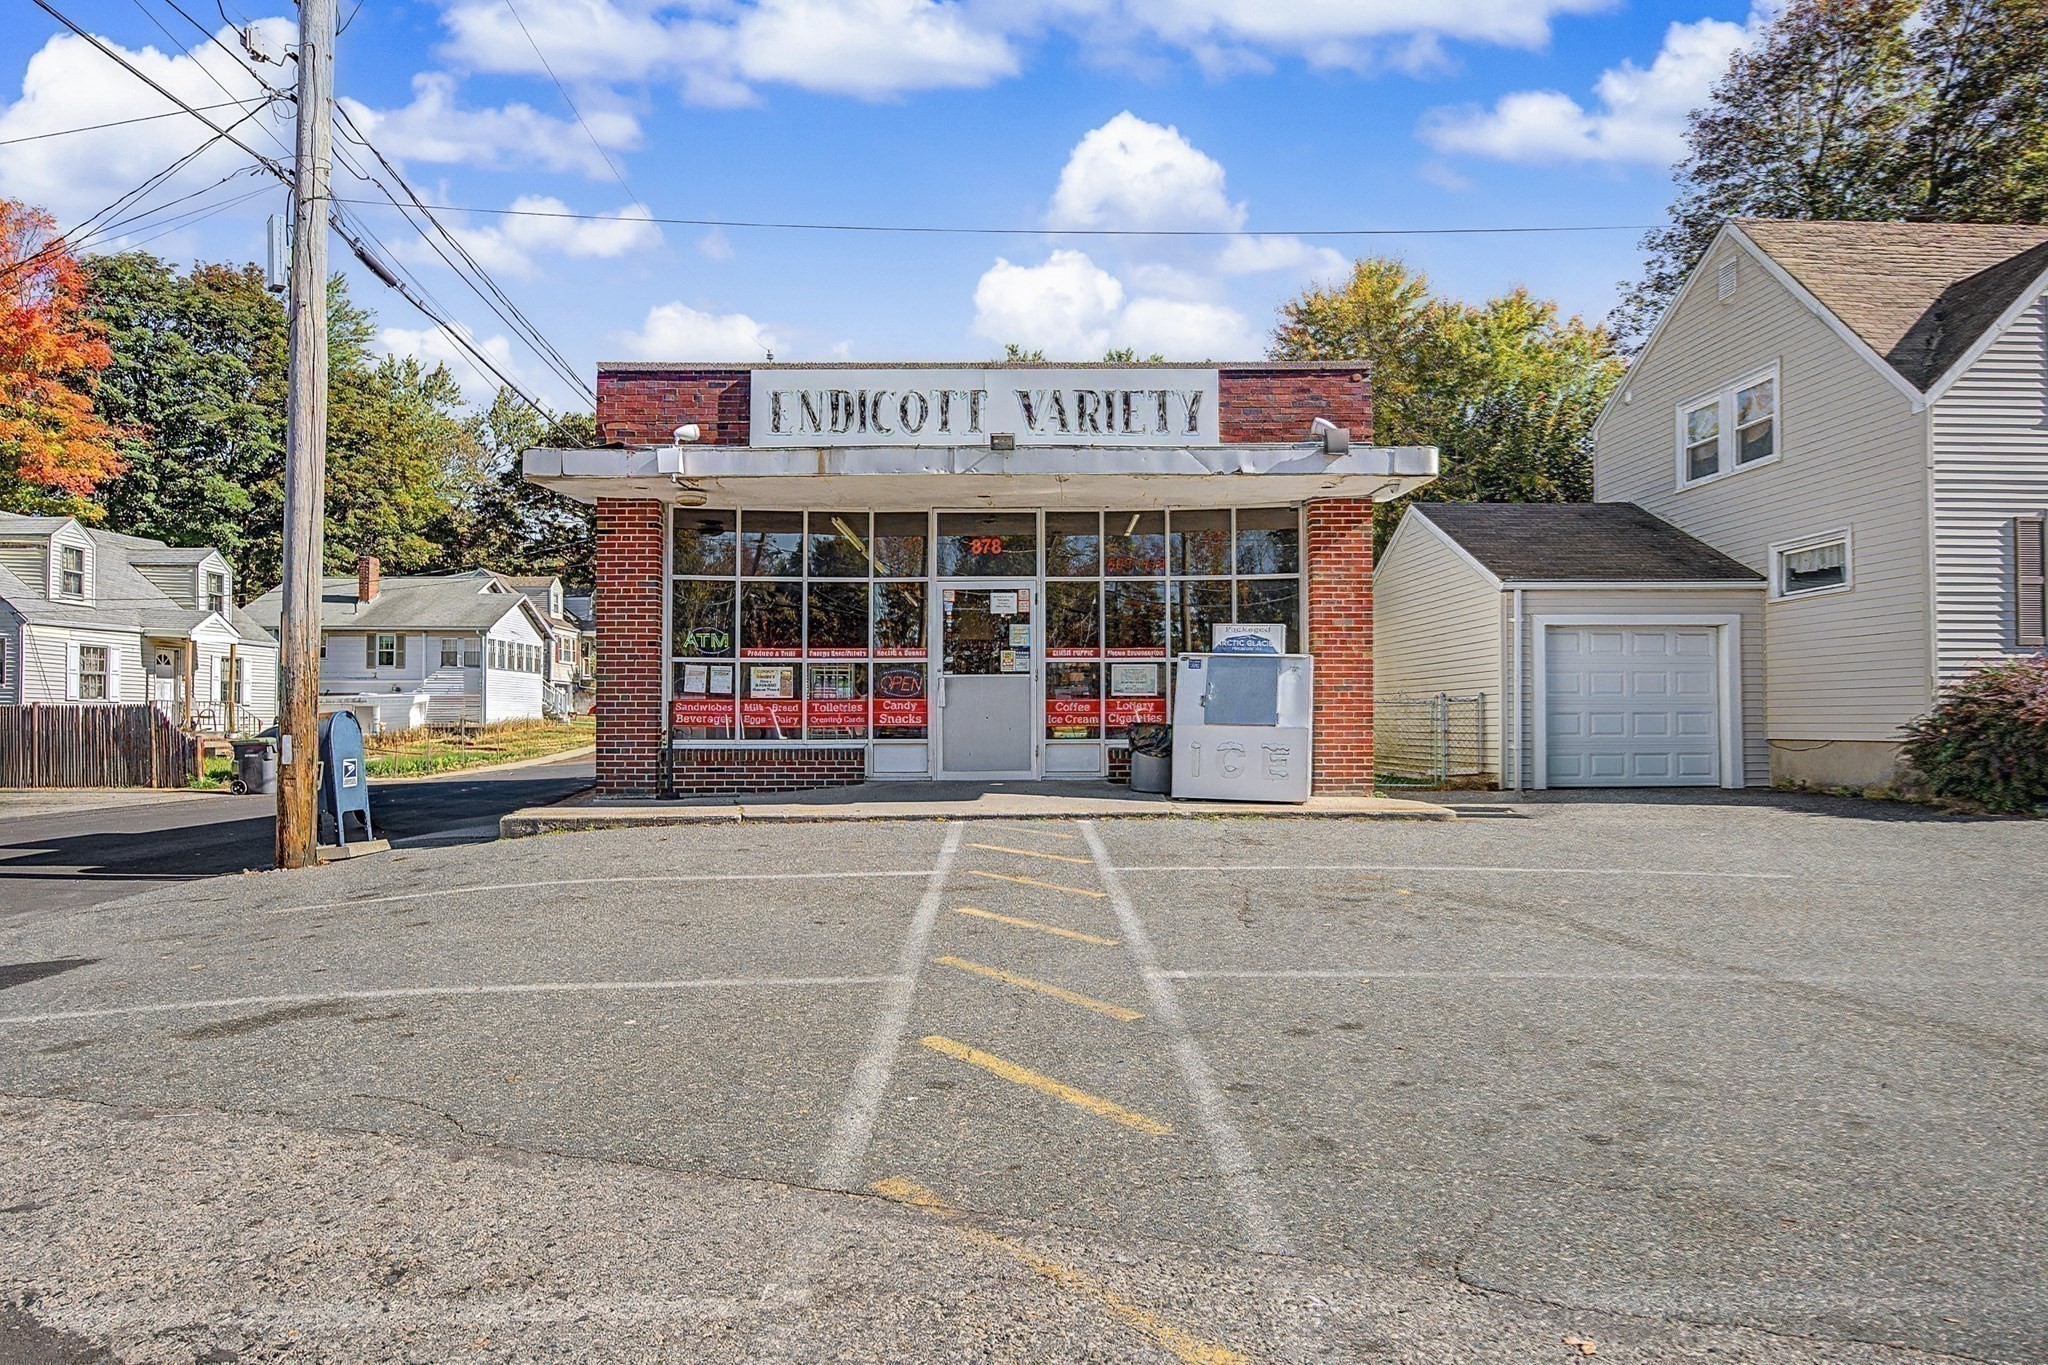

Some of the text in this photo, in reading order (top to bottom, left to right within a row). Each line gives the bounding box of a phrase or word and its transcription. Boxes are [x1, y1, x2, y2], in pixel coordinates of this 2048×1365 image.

[766, 388, 1205, 436] ENDICOTT VARIETY
[971, 538, 1001, 554] 878
[683, 631, 729, 648] ATM
[880, 675, 923, 691] OPEN
[675, 703, 733, 712] Sandwiches
[744, 703, 764, 711] Milk
[772, 703, 799, 712] Bread
[812, 703, 863, 712] Toiletries
[882, 701, 918, 712] Candy
[1055, 702, 1090, 712] Coffee
[1116, 701, 1154, 712] Lottery
[676, 714, 733, 725] Beverages
[744, 715, 766, 725] Eggs
[776, 715, 799, 725] Dairy
[879, 714, 922, 724] Snacks
[1047, 714, 1099, 724] Ice Cream
[1108, 714, 1162, 725] Cigarettes
[1191, 741, 1291, 780] ICE
